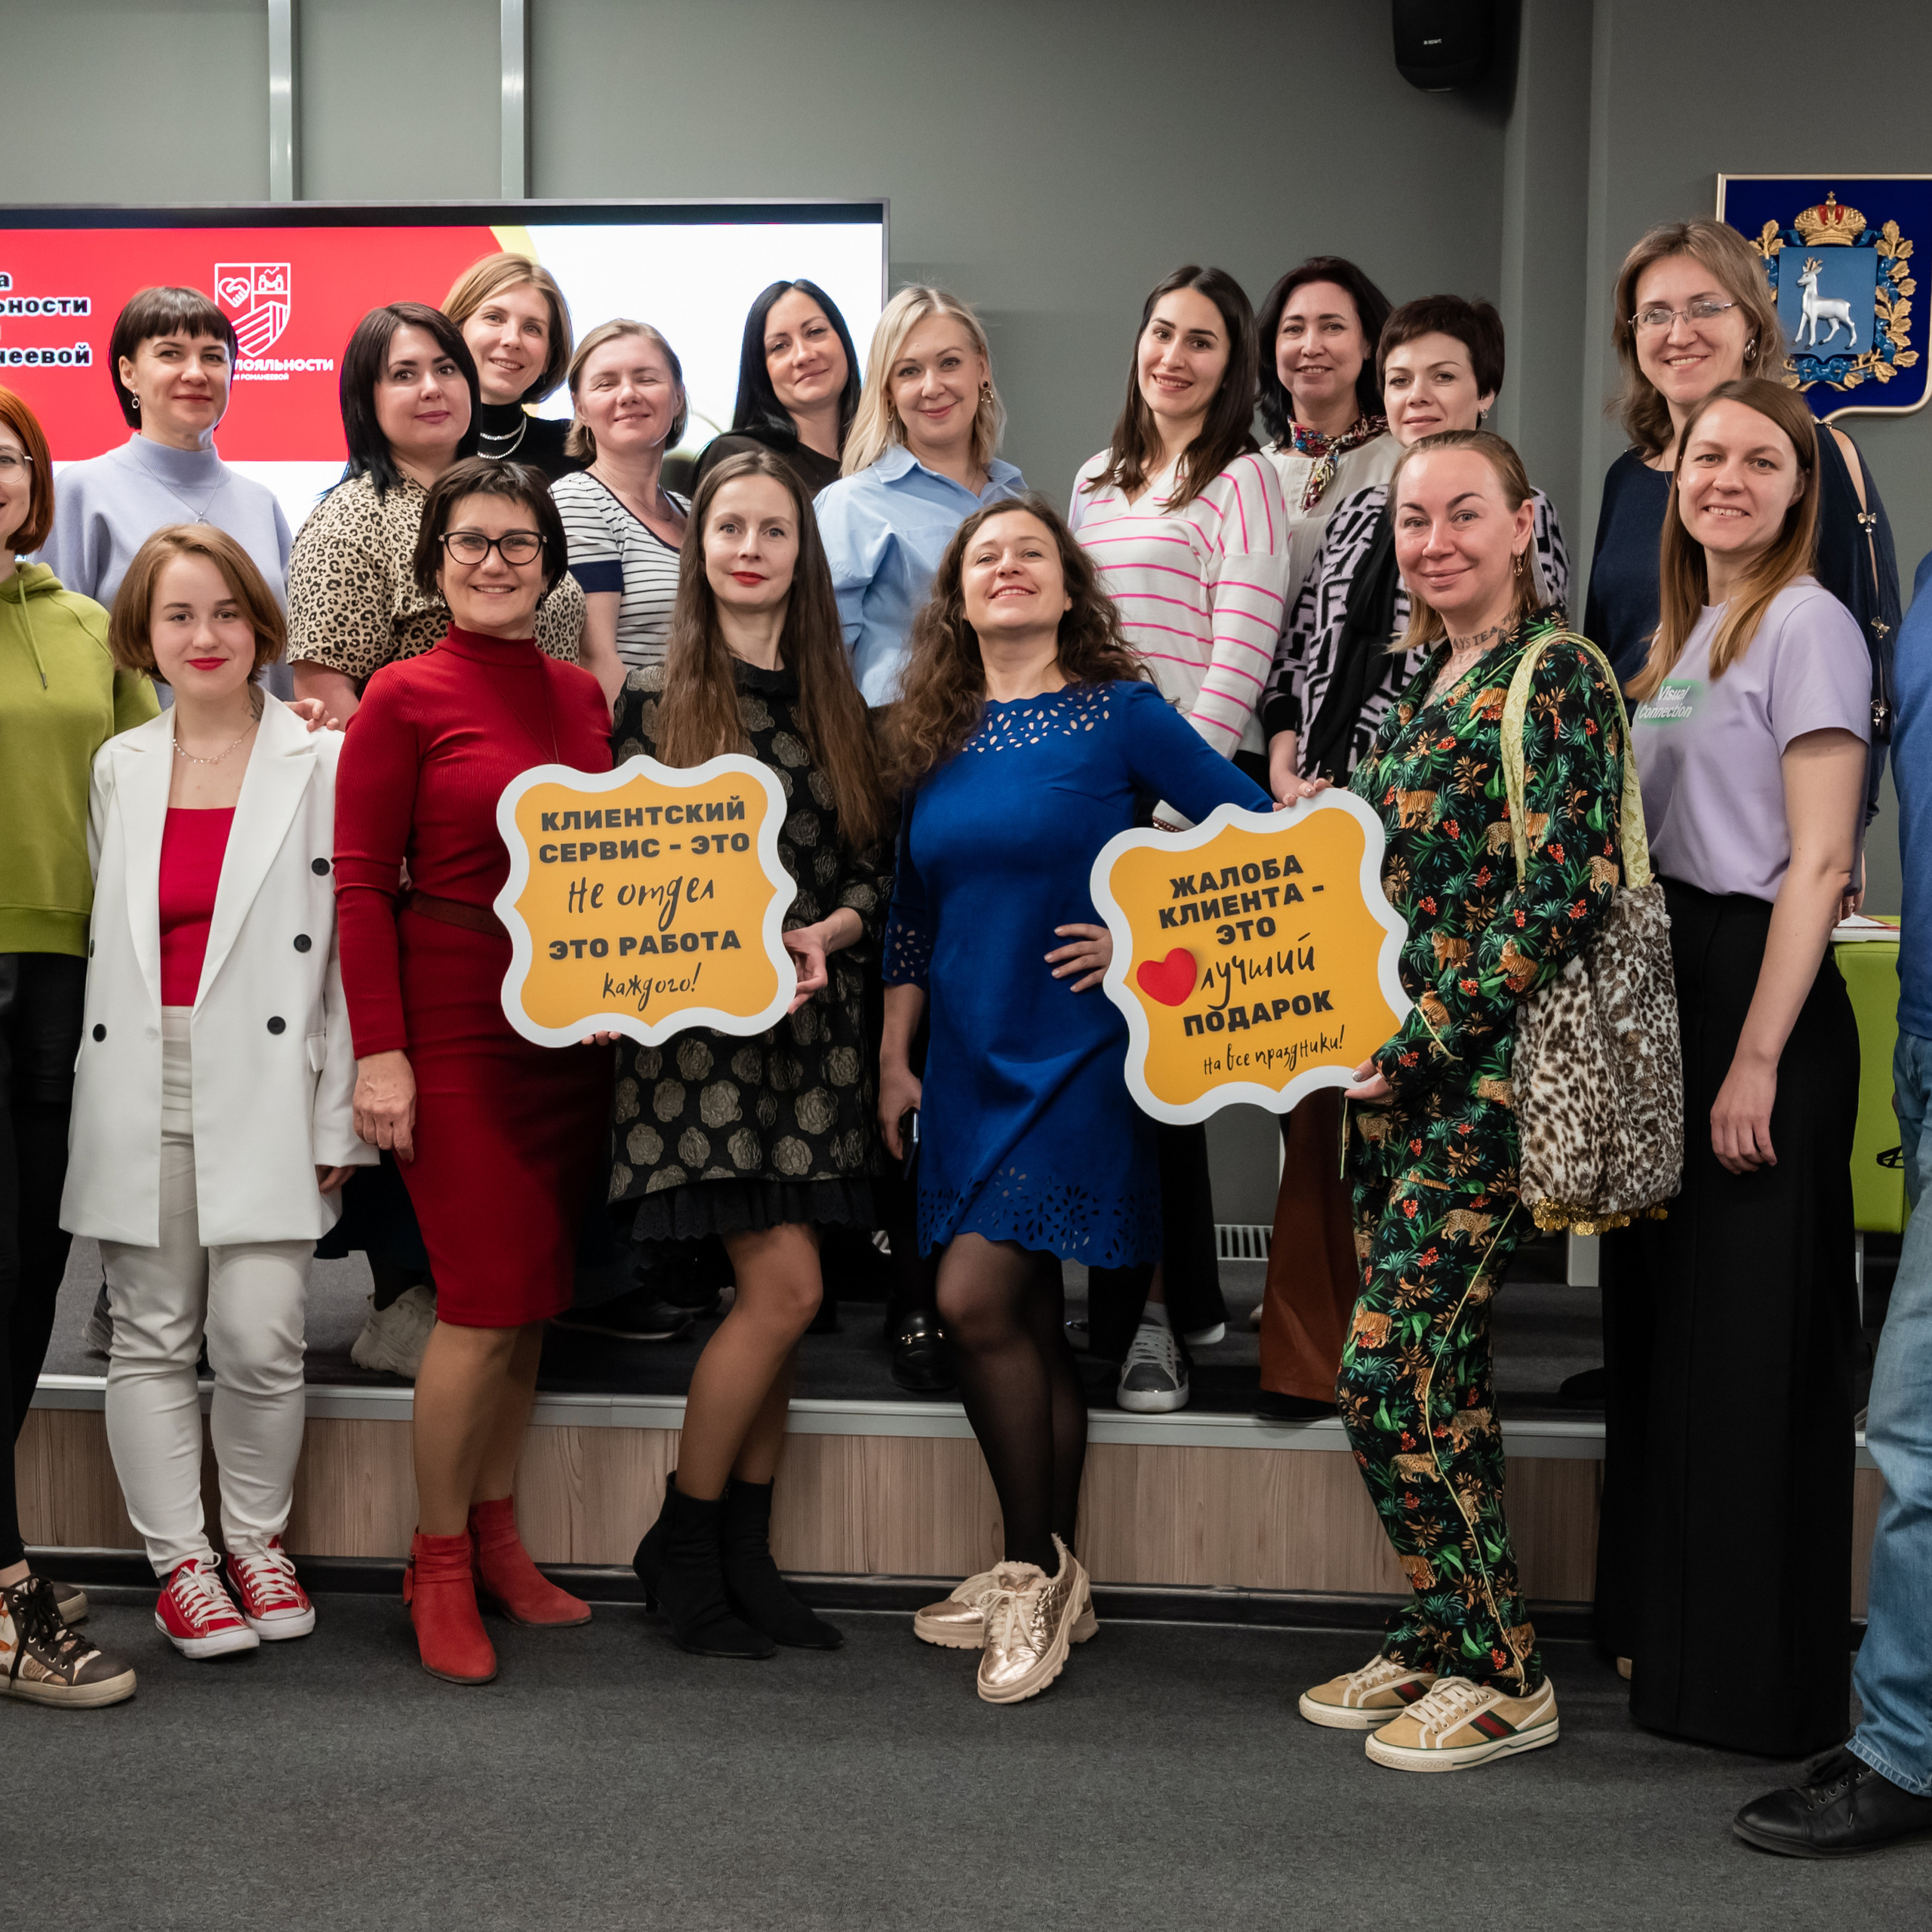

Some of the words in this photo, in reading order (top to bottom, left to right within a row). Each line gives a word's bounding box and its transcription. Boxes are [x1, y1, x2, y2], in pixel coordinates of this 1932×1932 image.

[235, 358, 334, 371] ЛОЯЛЬНОСТИ
[1658, 685, 1690, 701] Visual
[1638, 703, 1693, 719] Connection
[541, 795, 745, 832] КЛИЕНТСКИЙ
[539, 838, 660, 863] СЕРВИС
[691, 832, 750, 855] ЭТО
[1169, 854, 1304, 899] ЖАЛОБА
[617, 875, 714, 932] отдел
[1158, 883, 1305, 929] КЛИЕНТА
[549, 938, 609, 961] ЭТО
[619, 930, 742, 956] РАБОТА
[1216, 916, 1276, 946] ЭТО
[1183, 989, 1334, 1037] ПОДАРОК
[1227, 1043, 1250, 1071] все
[1255, 1024, 1345, 1072] праздники!
